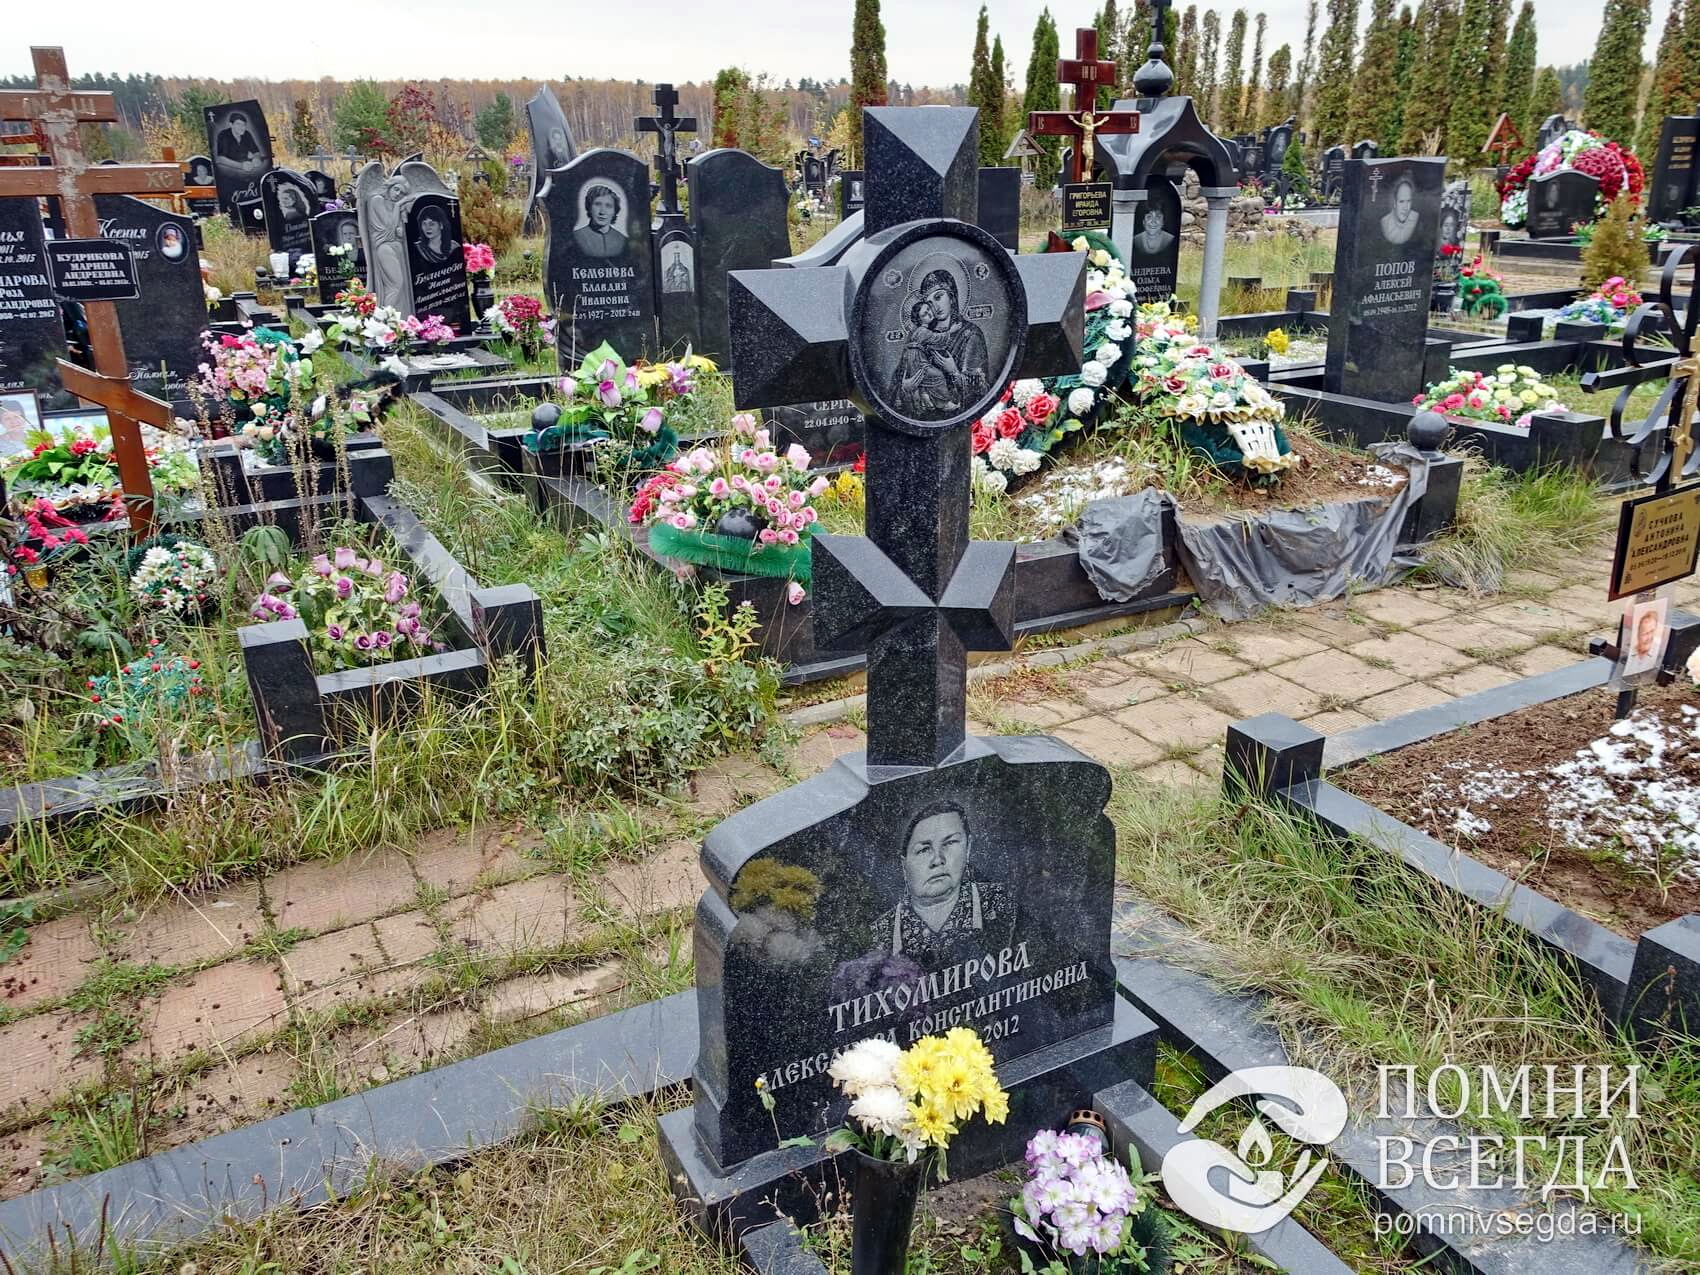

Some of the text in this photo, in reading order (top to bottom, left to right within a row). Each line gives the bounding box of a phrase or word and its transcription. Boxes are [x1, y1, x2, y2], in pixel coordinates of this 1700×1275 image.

[1374, 261, 1416, 277] ПОПОВ
[1374, 276, 1413, 291] АЛЕКСЕЙ
[1361, 289, 1422, 305] АФАНАСЬЕВИЧ
[828, 941, 1031, 1034] ТИХОМИРОВА
[908, 961, 1089, 1041] КОНСТАНТИНОВНА
[983, 1014, 1020, 1045] 2012
